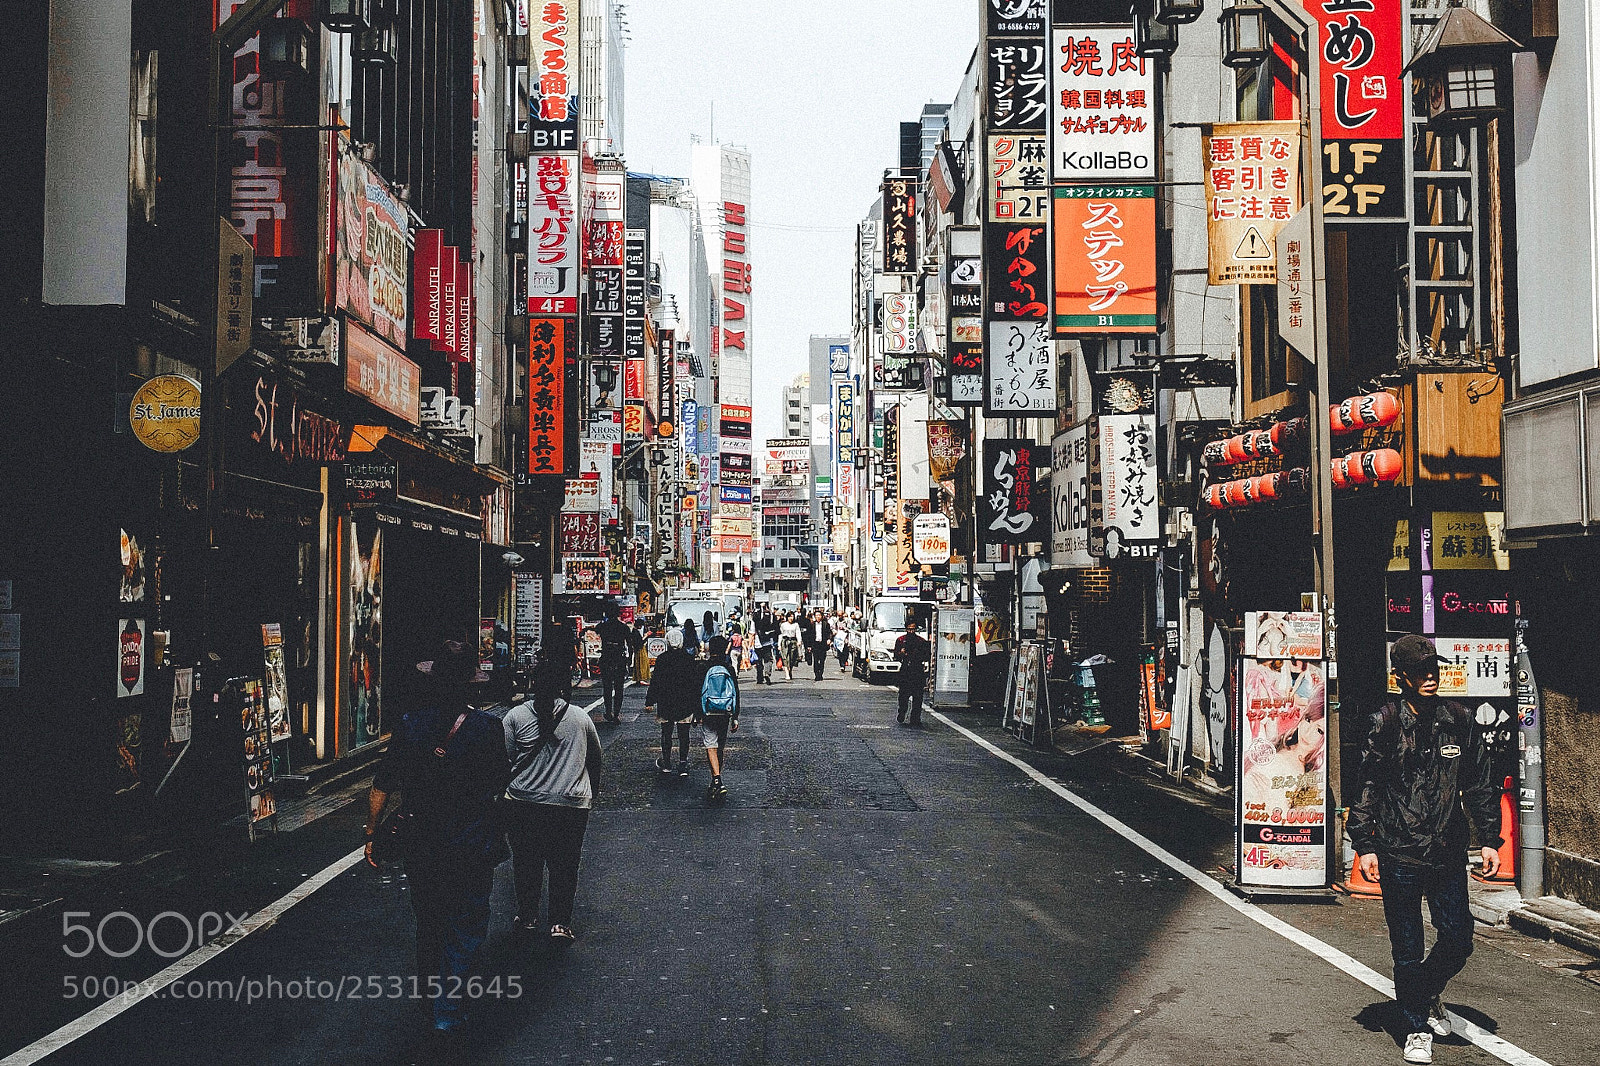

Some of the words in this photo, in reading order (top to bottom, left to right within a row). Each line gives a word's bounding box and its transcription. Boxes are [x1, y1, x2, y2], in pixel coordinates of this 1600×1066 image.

[540, 2, 568, 120] まぐろ商店
[1060, 36, 1146, 76] 焼肉
[1323, 0, 1378, 129] めし
[990, 46, 1016, 126] ゼーション
[1018, 46, 1046, 124] リラク
[1060, 89, 1147, 109] 韓国料理
[533, 130, 574, 147] B1F
[1060, 114, 1147, 134] サムギョプサル
[1018, 137, 1046, 191] 麻雀
[1062, 151, 1148, 169] KollaBo
[1210, 138, 1291, 162] 悪質な
[1323, 142, 1383, 174] 1F
[994, 136, 1015, 218] クアトロ
[1066, 188, 1143, 198] オンラインカフェ
[1211, 167, 1291, 192] 客引き
[533, 156, 574, 264] 熟女キャバクラ
[1018, 196, 1046, 217] 2F
[1213, 197, 1292, 220] に注意
[1323, 184, 1386, 215] 2F
[1082, 202, 1128, 312] ステップ
[429, 267, 439, 335] ANRAKUTEI
[594, 281, 606, 311] ルーム
[608, 270, 619, 311] レンタル
[953, 294, 981, 306] 日本人セ
[1286, 240, 1302, 328] 劇場通り一番街
[445, 282, 455, 350] ANRAKUTEI
[540, 299, 565, 313] 4F
[1098, 316, 1114, 326] B1
[460, 296, 470, 359] ANRAKUTEI
[1029, 321, 1052, 391] 居酒屋
[591, 426, 621, 434] XROSS
[839, 386, 852, 461] まんが喫茶
[841, 465, 852, 504] マンボー
[1015, 448, 1031, 511] 東京豚骨
[1119, 424, 1155, 528] お好み焼き
[1131, 545, 1159, 557] B1F
[1259, 828, 1311, 843] G-SCANDAL
[1246, 847, 1270, 867] 4F
